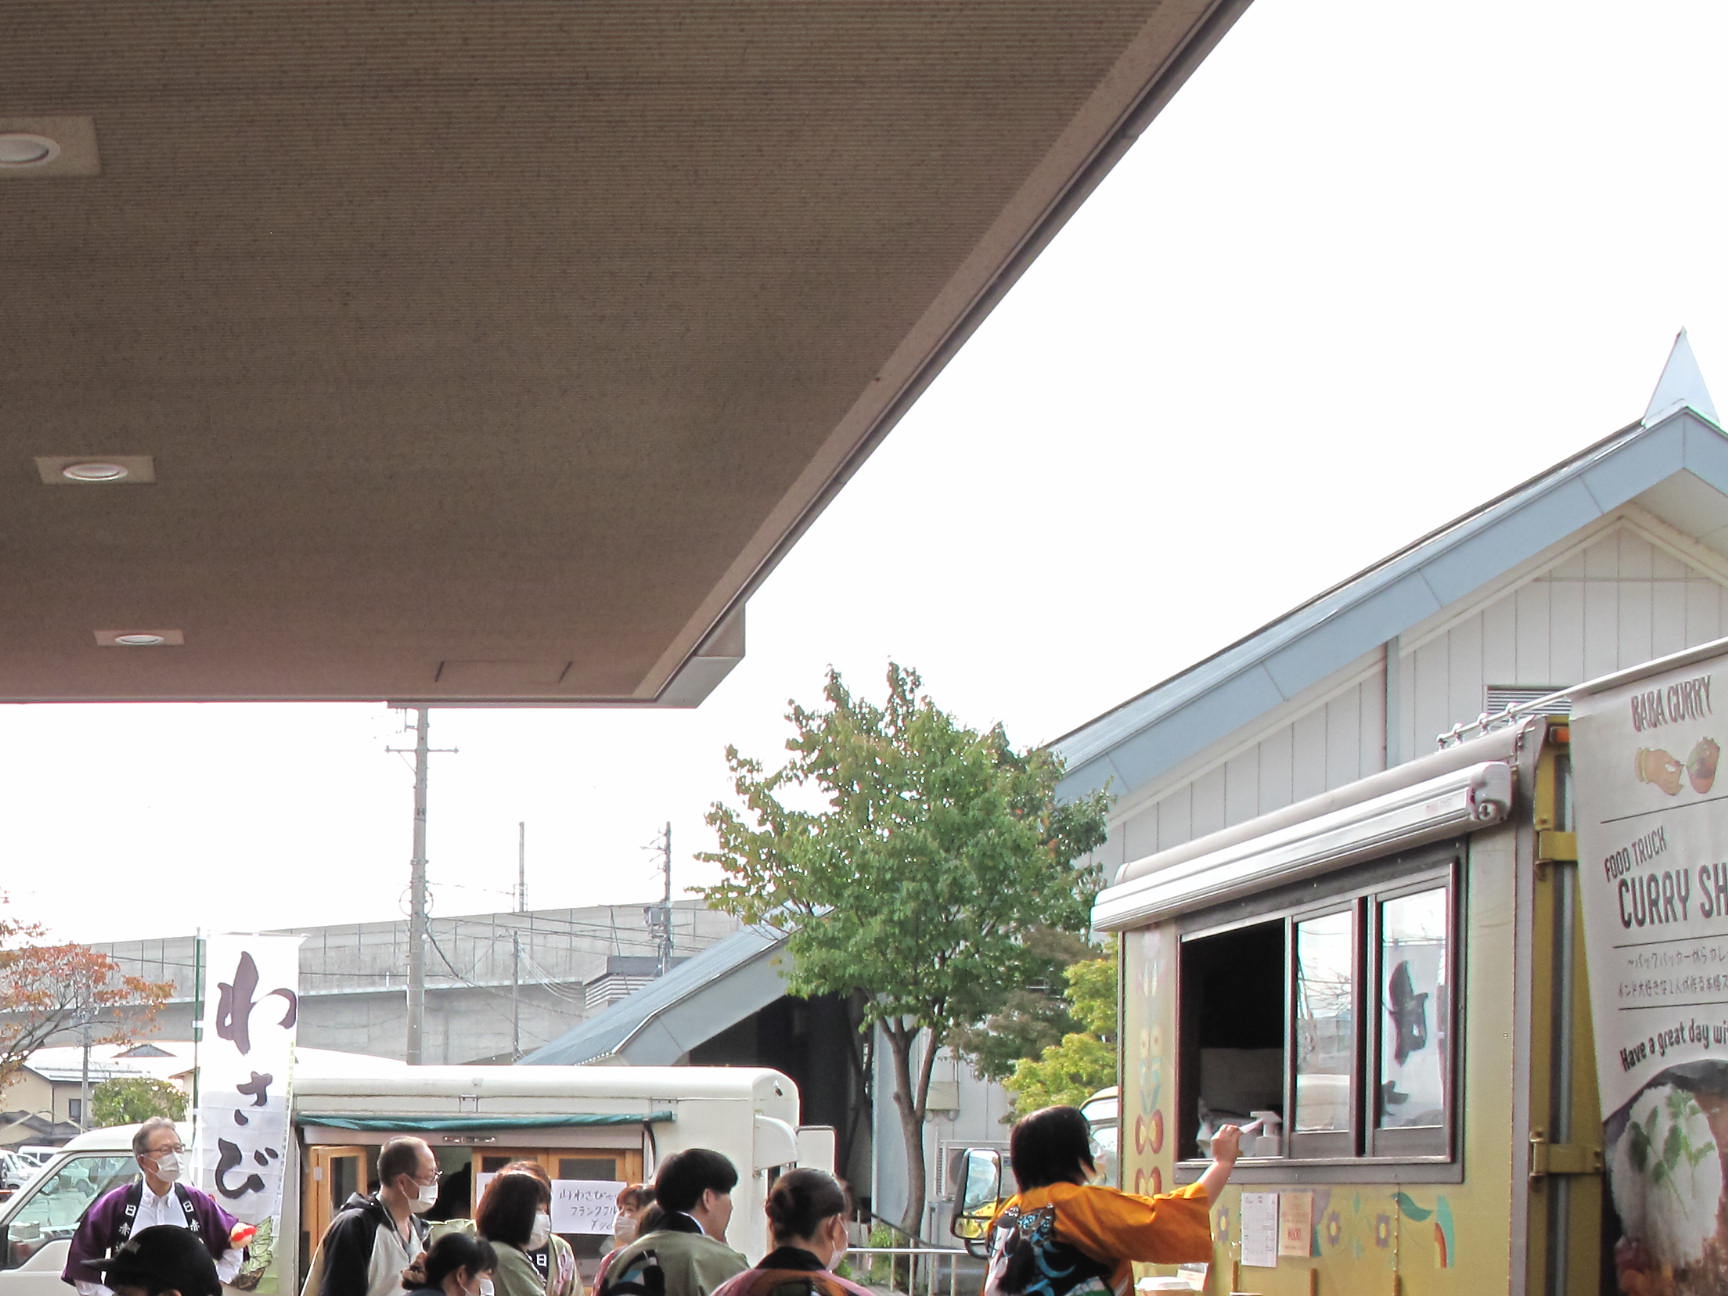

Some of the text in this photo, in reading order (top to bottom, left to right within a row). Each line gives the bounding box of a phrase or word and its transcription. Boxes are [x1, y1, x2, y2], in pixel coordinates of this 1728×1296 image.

[1630, 674, 1713, 732] BABA CURRY
[1604, 825, 1668, 883] FOOD TRUCK
[1617, 867, 1690, 929] CURRY
[1619, 1042, 1647, 1072] Have
[1648, 1037, 1656, 1055] a
[1657, 1021, 1686, 1057] great
[1688, 1018, 1710, 1050] day
[215, 950, 298, 1200] わさび
